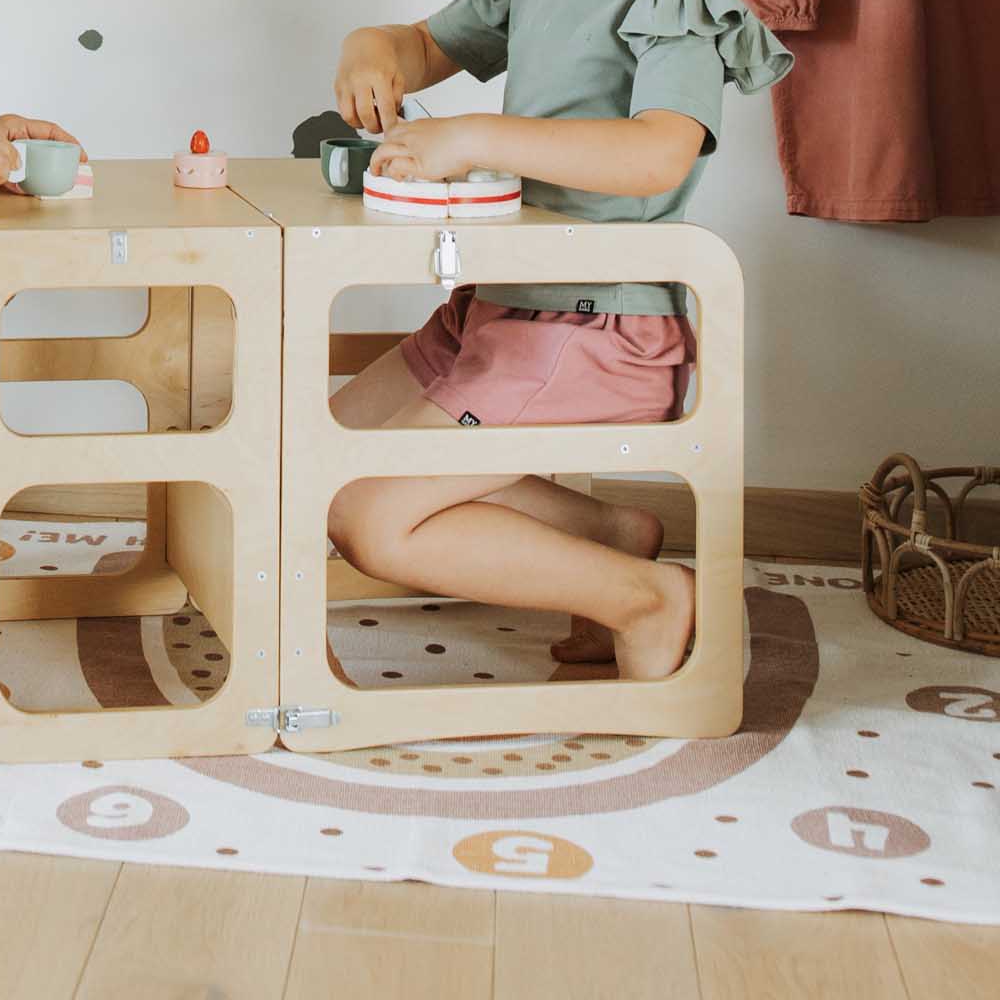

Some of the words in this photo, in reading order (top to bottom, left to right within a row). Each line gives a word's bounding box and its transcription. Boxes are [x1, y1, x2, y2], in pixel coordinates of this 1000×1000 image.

[938, 692, 997, 718] 2
[826, 812, 889, 851] 4
[491, 836, 554, 873] 5
